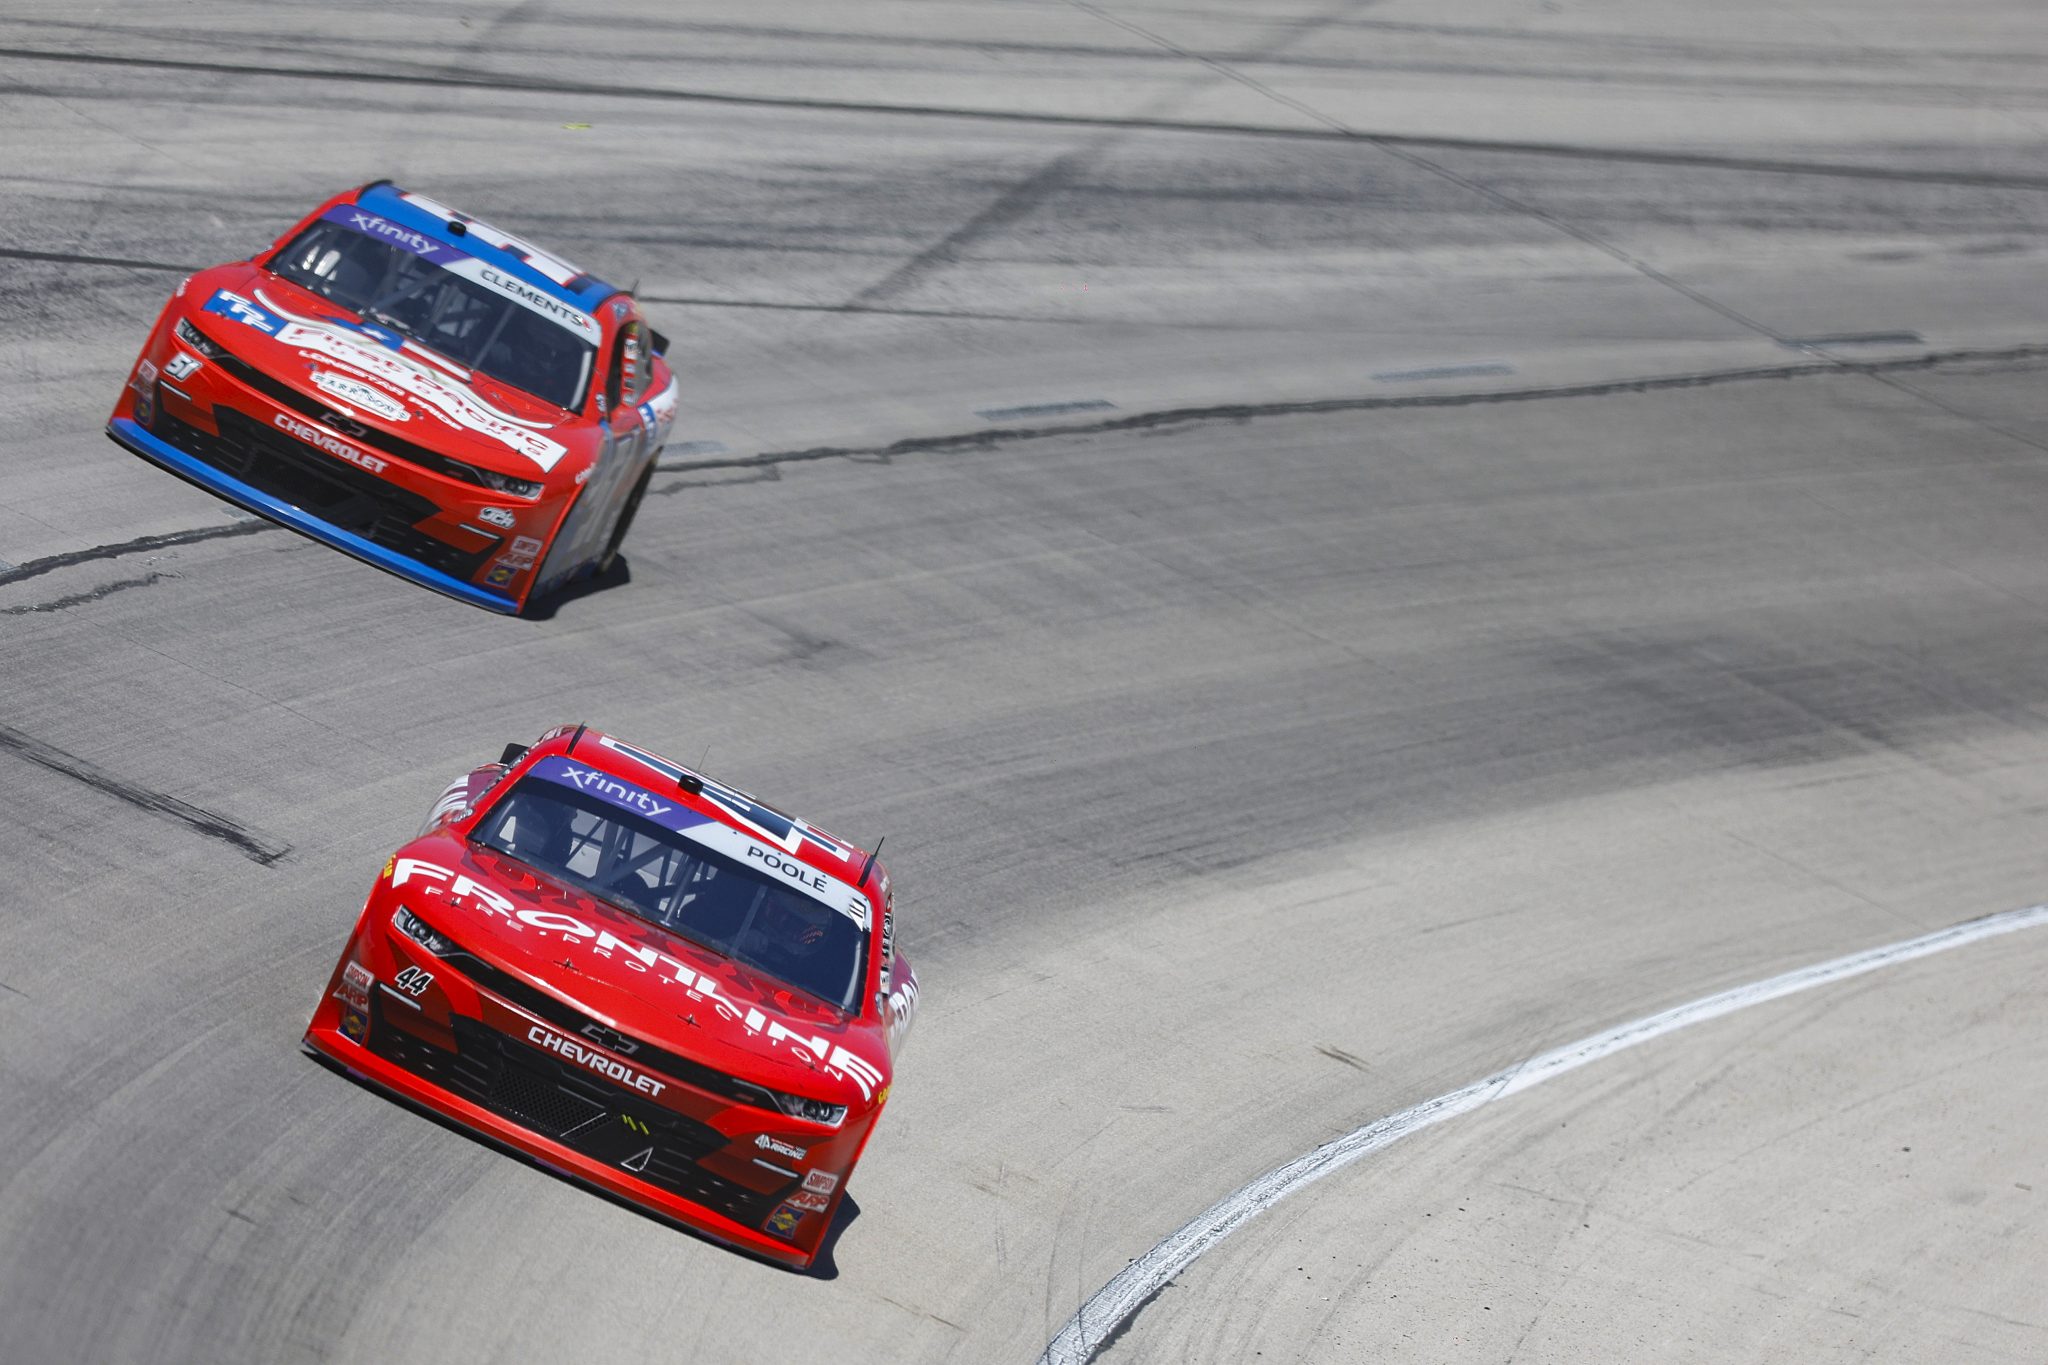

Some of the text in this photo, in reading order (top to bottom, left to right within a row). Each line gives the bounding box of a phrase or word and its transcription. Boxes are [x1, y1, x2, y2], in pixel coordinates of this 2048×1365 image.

[349, 213, 440, 255] xfinity
[481, 269, 584, 327] CLEMENTS
[165, 352, 203, 381] 51
[412, 374, 549, 451] Pacific
[274, 413, 389, 474] CHEVROLET
[561, 766, 672, 817] xfinity
[747, 845, 828, 894] POOLE
[391, 858, 884, 1102] FRONTLINE
[395, 965, 435, 996] 44
[527, 1025, 667, 1098] CHEVROLET
